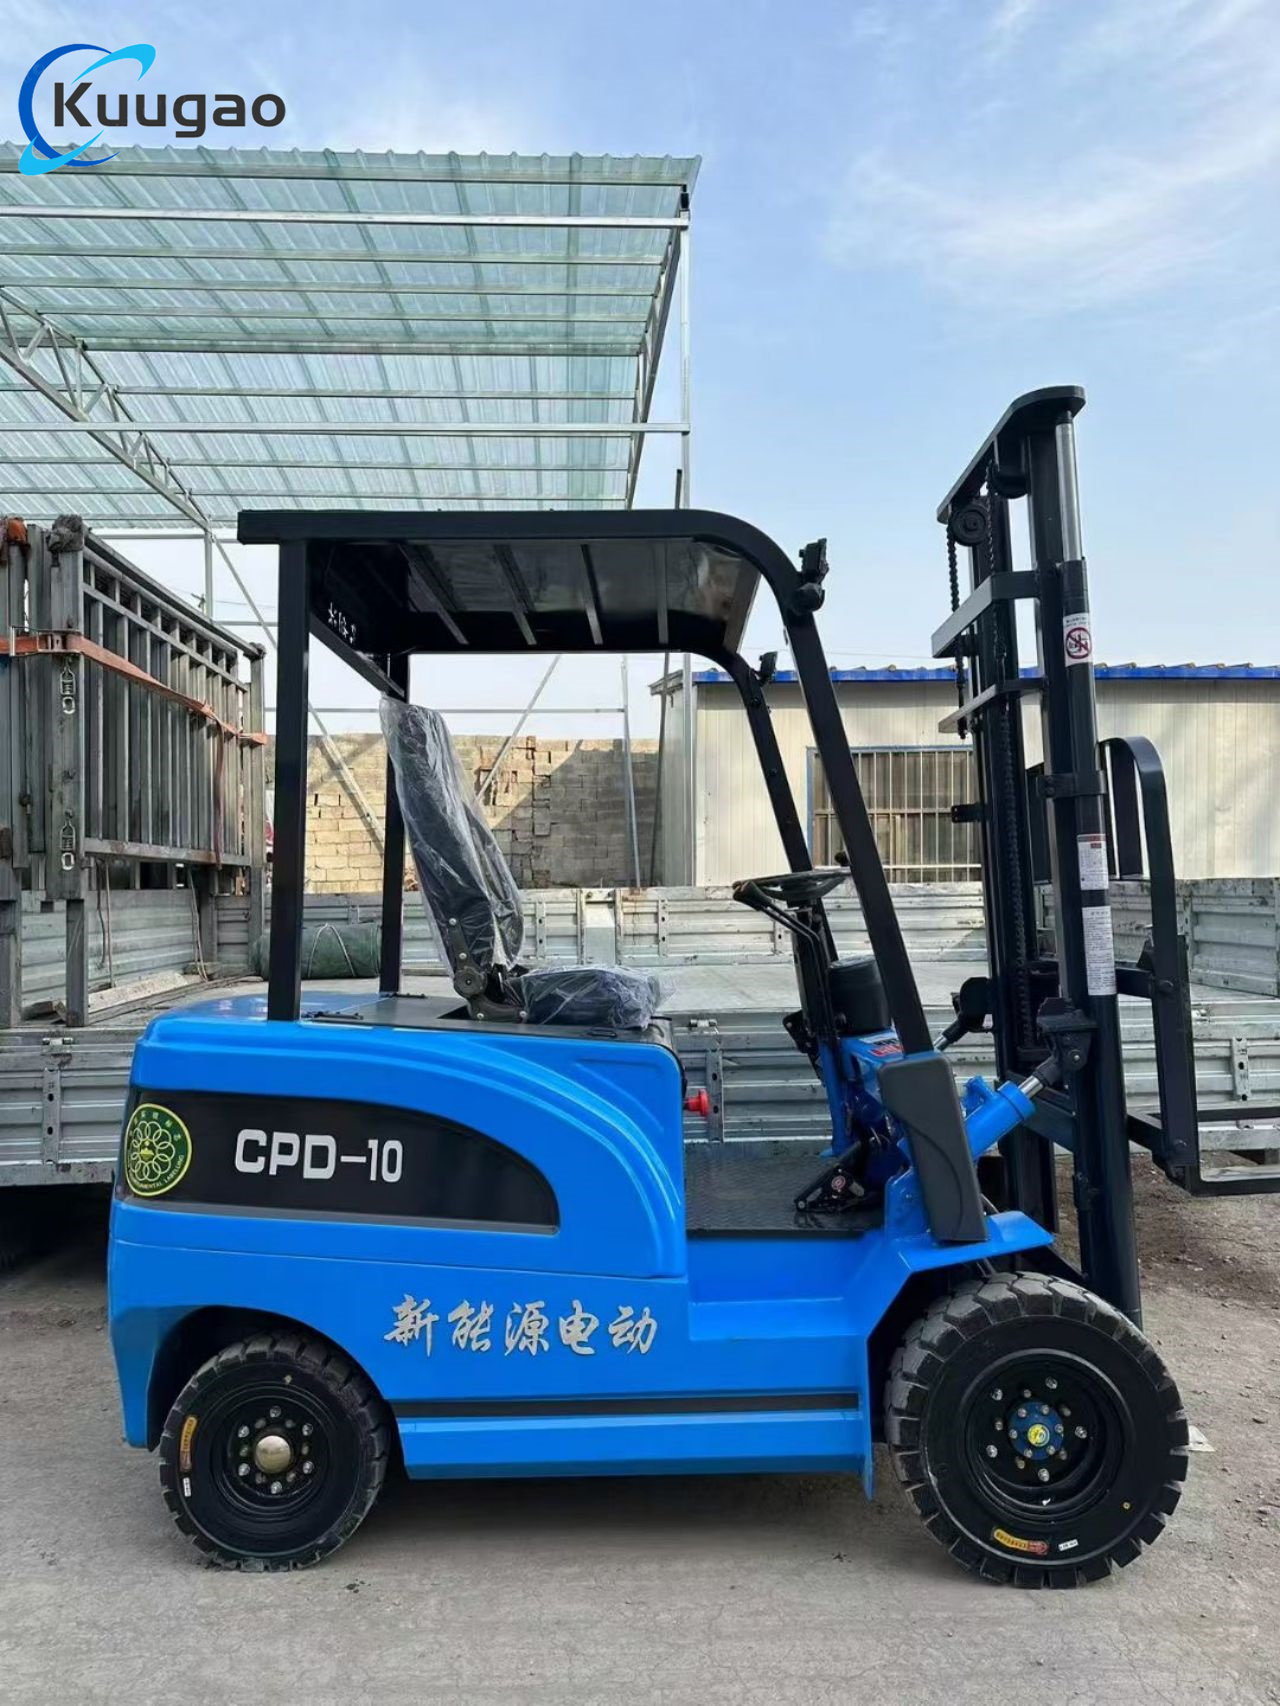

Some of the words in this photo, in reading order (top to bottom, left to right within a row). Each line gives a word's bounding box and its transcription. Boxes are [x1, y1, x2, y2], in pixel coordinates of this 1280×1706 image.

[235, 1129, 403, 1183] CPD-10
[384, 1294, 659, 1357] 新能源电动
